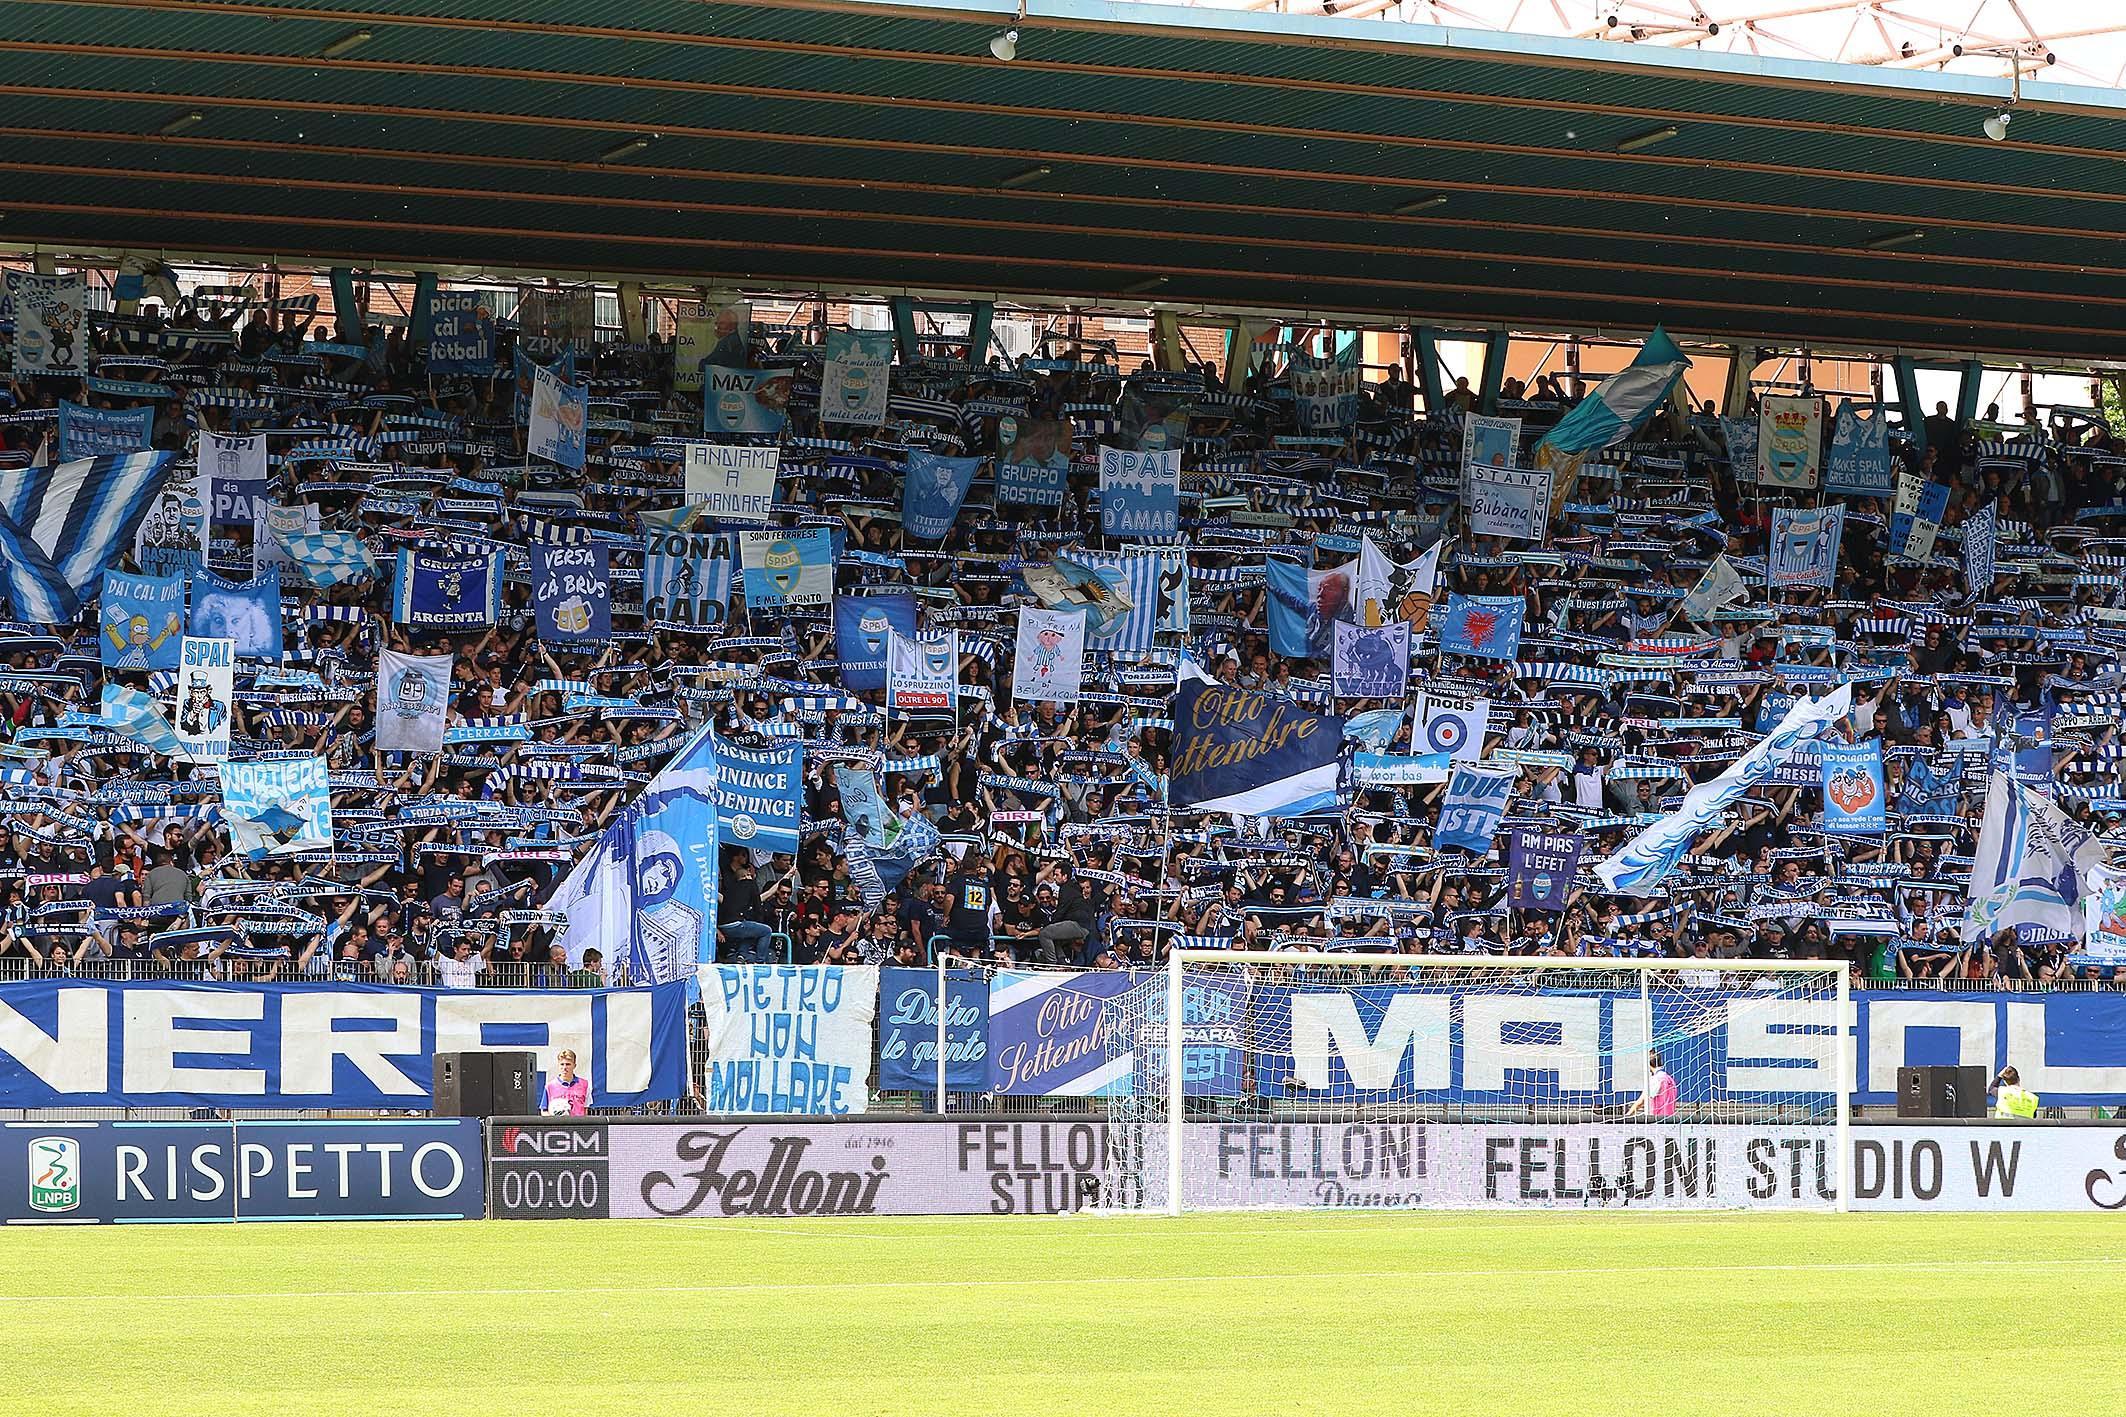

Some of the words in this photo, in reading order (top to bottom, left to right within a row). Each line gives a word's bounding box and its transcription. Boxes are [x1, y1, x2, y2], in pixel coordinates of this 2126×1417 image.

[678, 335, 696, 347] DA
[213, 437, 256, 451] TIPI
[694, 449, 776, 470] ANDIAMO
[1104, 450, 1177, 479] SPAL
[1859, 457, 1885, 473] SPAL
[726, 470, 739, 488] A
[1001, 464, 1059, 485] GRUPPO
[1859, 471, 1890, 487] AGAIN
[222, 481, 239, 494] da
[750, 531, 769, 542] SONO
[771, 529, 818, 541] FERRARESE
[646, 533, 731, 561] ZONA
[419, 556, 483, 571] GRUPPO
[544, 549, 597, 569] VERSA
[109, 578, 131, 597] DAI
[133, 582, 158, 602] CAL
[763, 596, 777, 606] ME
[778, 596, 790, 606] NE
[791, 593, 822, 605] VANTO
[412, 610, 485, 624] ARGENTA
[646, 596, 725, 626] GAD
[184, 640, 231, 668] SPAL
[893, 680, 903, 689] LO
[904, 680, 951, 691] SPRUZZINO
[898, 696, 922, 705] OLTRE
[923, 696, 930, 705] IL
[1192, 688, 1267, 730] Otto
[1428, 697, 1475, 712] mods
[458, 728, 522, 739] FERRARA
[205, 740, 227, 756] YOU
[1450, 772, 1513, 799] DUE
[1520, 834, 1542, 849] AM
[1544, 837, 1575, 853] PIAS
[969, 890, 983, 903] 12
[1036, 992, 1094, 1039] Otto
[880, 1028, 907, 1061] le
[709, 1061, 851, 1115] MOLLARE
[516, 1130, 602, 1154] NGM
[844, 1136, 864, 1149] dal
[866, 1136, 895, 1149] 1946
[1219, 1125, 1428, 1180] FELLONI
[115, 1141, 466, 1202] RISPETTO
[640, 1126, 891, 1218] Felloni
[1485, 1137, 1717, 1201] FELLONI
[1746, 1137, 1944, 1201] STUDIO
[1969, 1139, 2022, 1199] W
[36, 1191, 73, 1206] LNPB
[502, 1170, 598, 1209] 00:00
